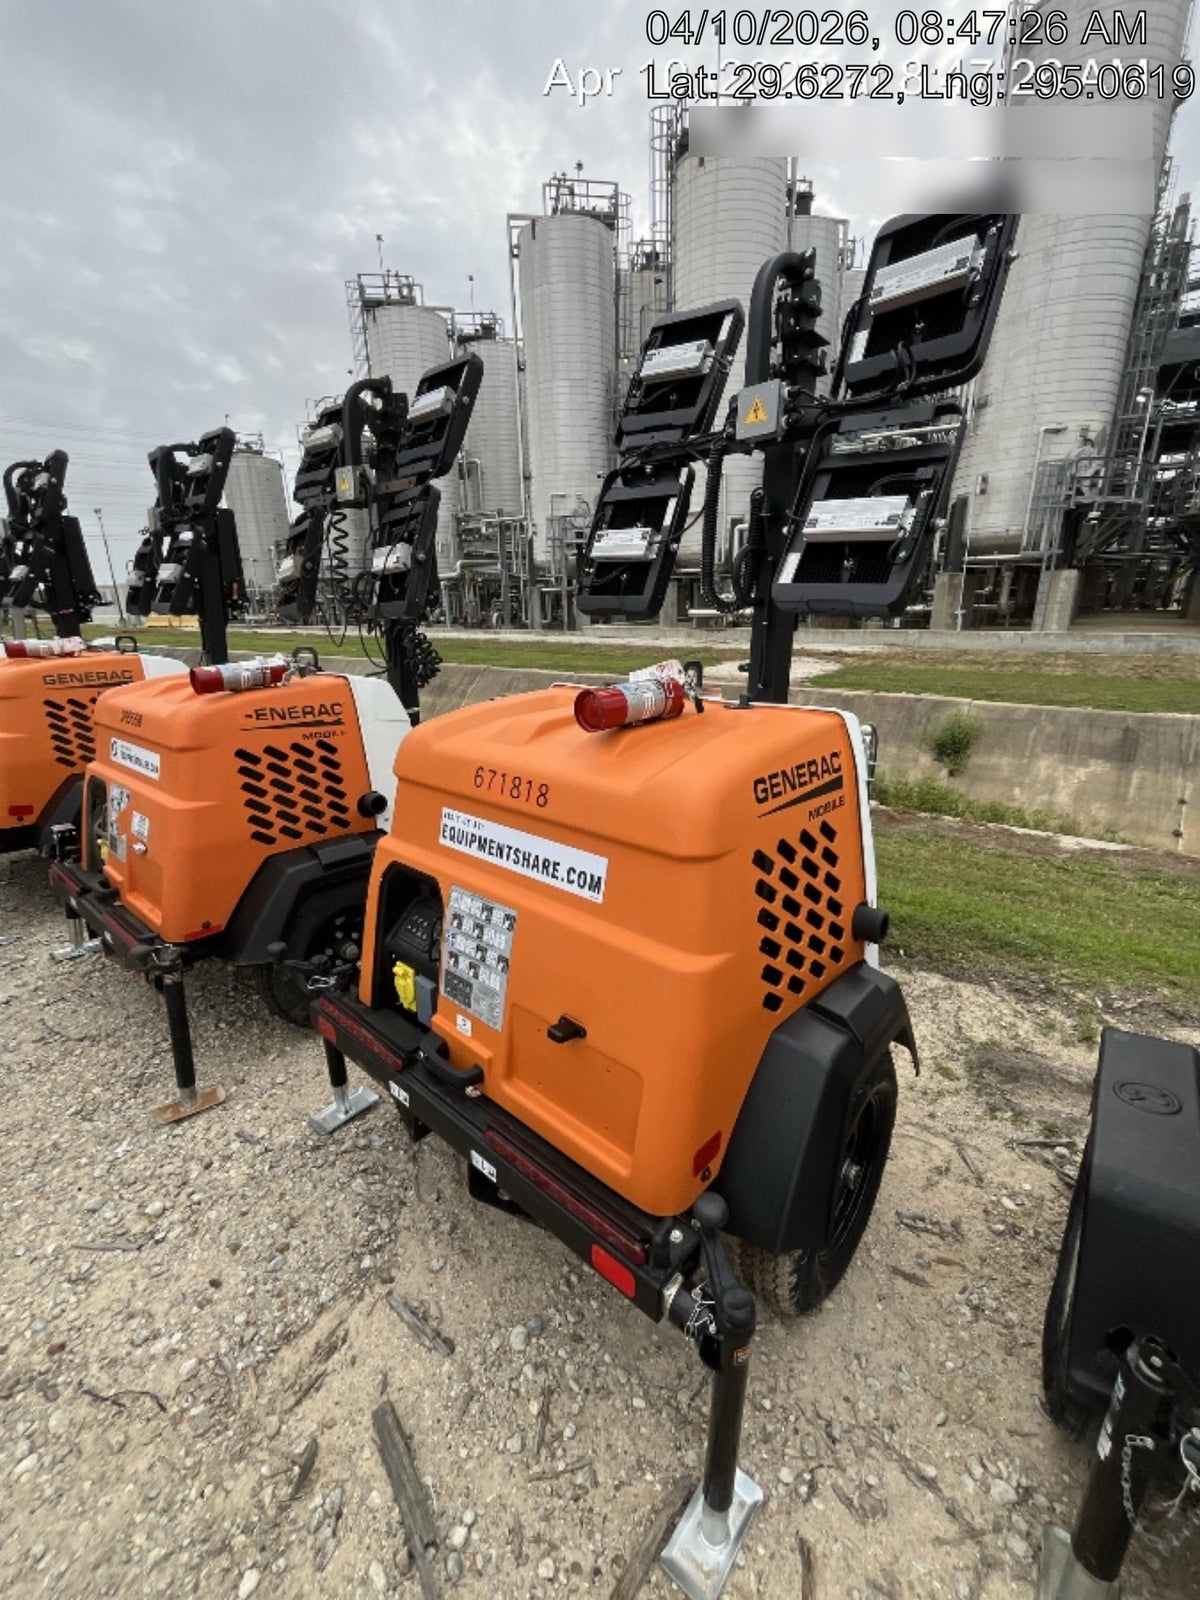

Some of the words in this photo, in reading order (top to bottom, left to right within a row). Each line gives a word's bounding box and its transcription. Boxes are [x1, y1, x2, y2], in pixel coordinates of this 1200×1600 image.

[42, 669, 133, 686] GENERAC
[474, 766, 549, 807] 671818
[753, 750, 842, 805] GENERAC
[442, 822, 602, 896] EQUIPMENTSHARE.COM
